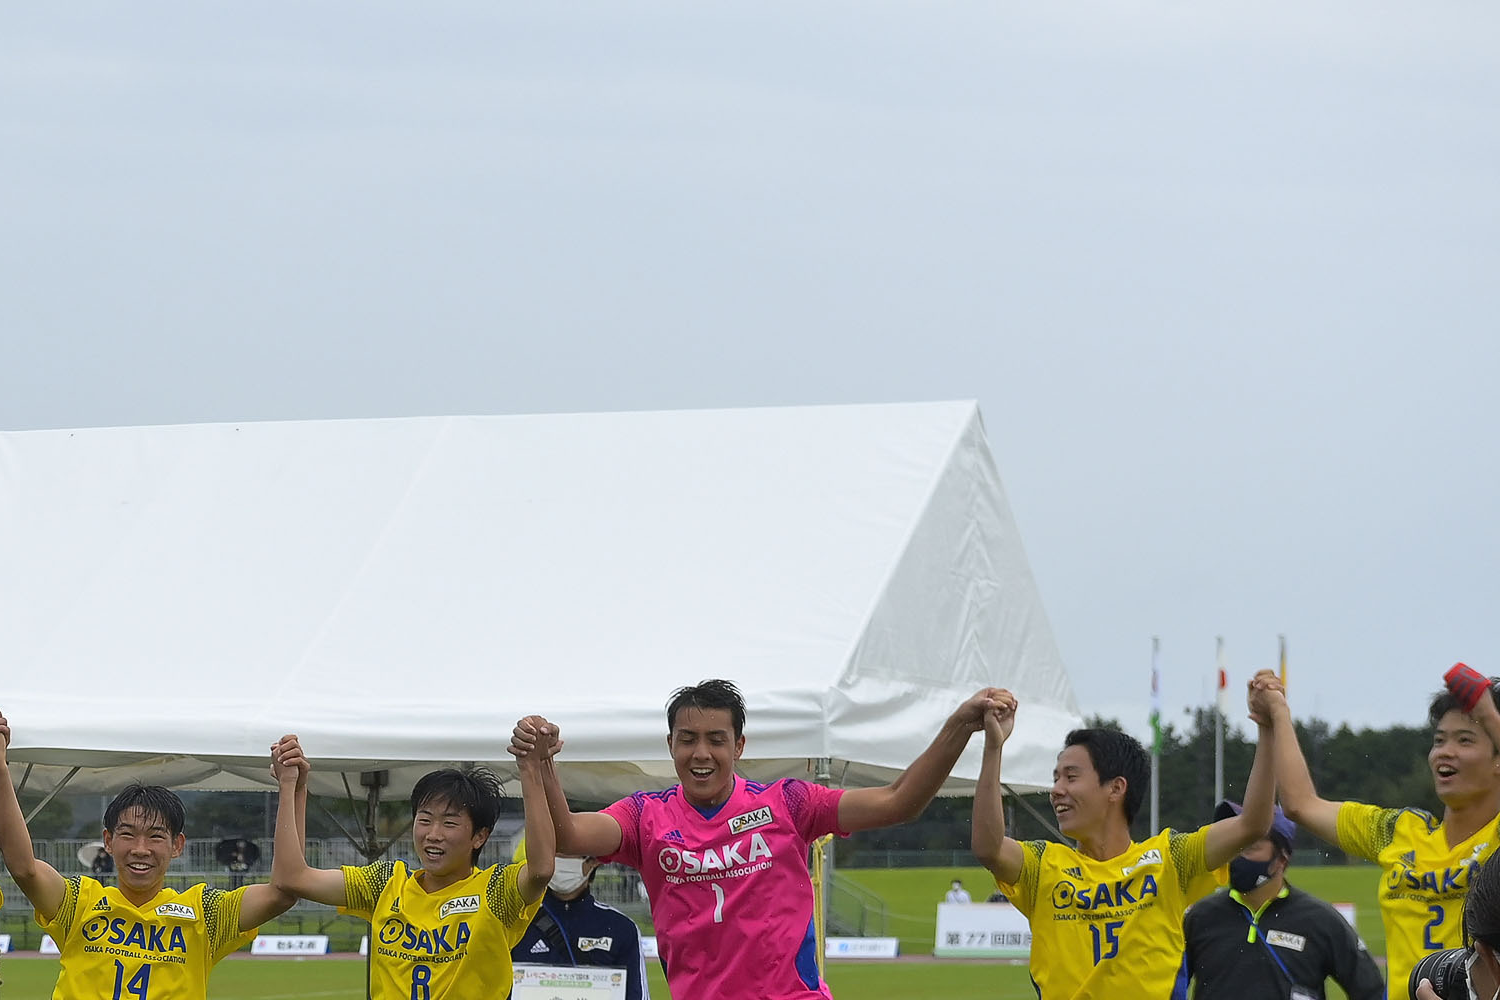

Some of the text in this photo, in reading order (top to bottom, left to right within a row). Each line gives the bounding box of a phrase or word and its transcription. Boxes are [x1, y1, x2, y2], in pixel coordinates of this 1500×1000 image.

[732, 809, 770, 832] OSAKA
[658, 833, 773, 874] OSAKA
[687, 873, 725, 883] FOOTBALL
[725, 860, 773, 879] ASSOCIATION
[441, 898, 478, 914] OSAKA
[711, 883, 725, 923] 1
[1051, 874, 1158, 910] OSAKA
[158, 903, 193, 916] OSAKA
[82, 916, 187, 953] OSAKA
[379, 918, 472, 955] OSAKA
[1423, 904, 1445, 950] 2
[84, 945, 187, 965] OSAKA FOOTBALL ASSOCIATION
[377, 947, 399, 959] OSAKA
[1089, 920, 1125, 967] 15
[591, 974, 609, 982] 2022
